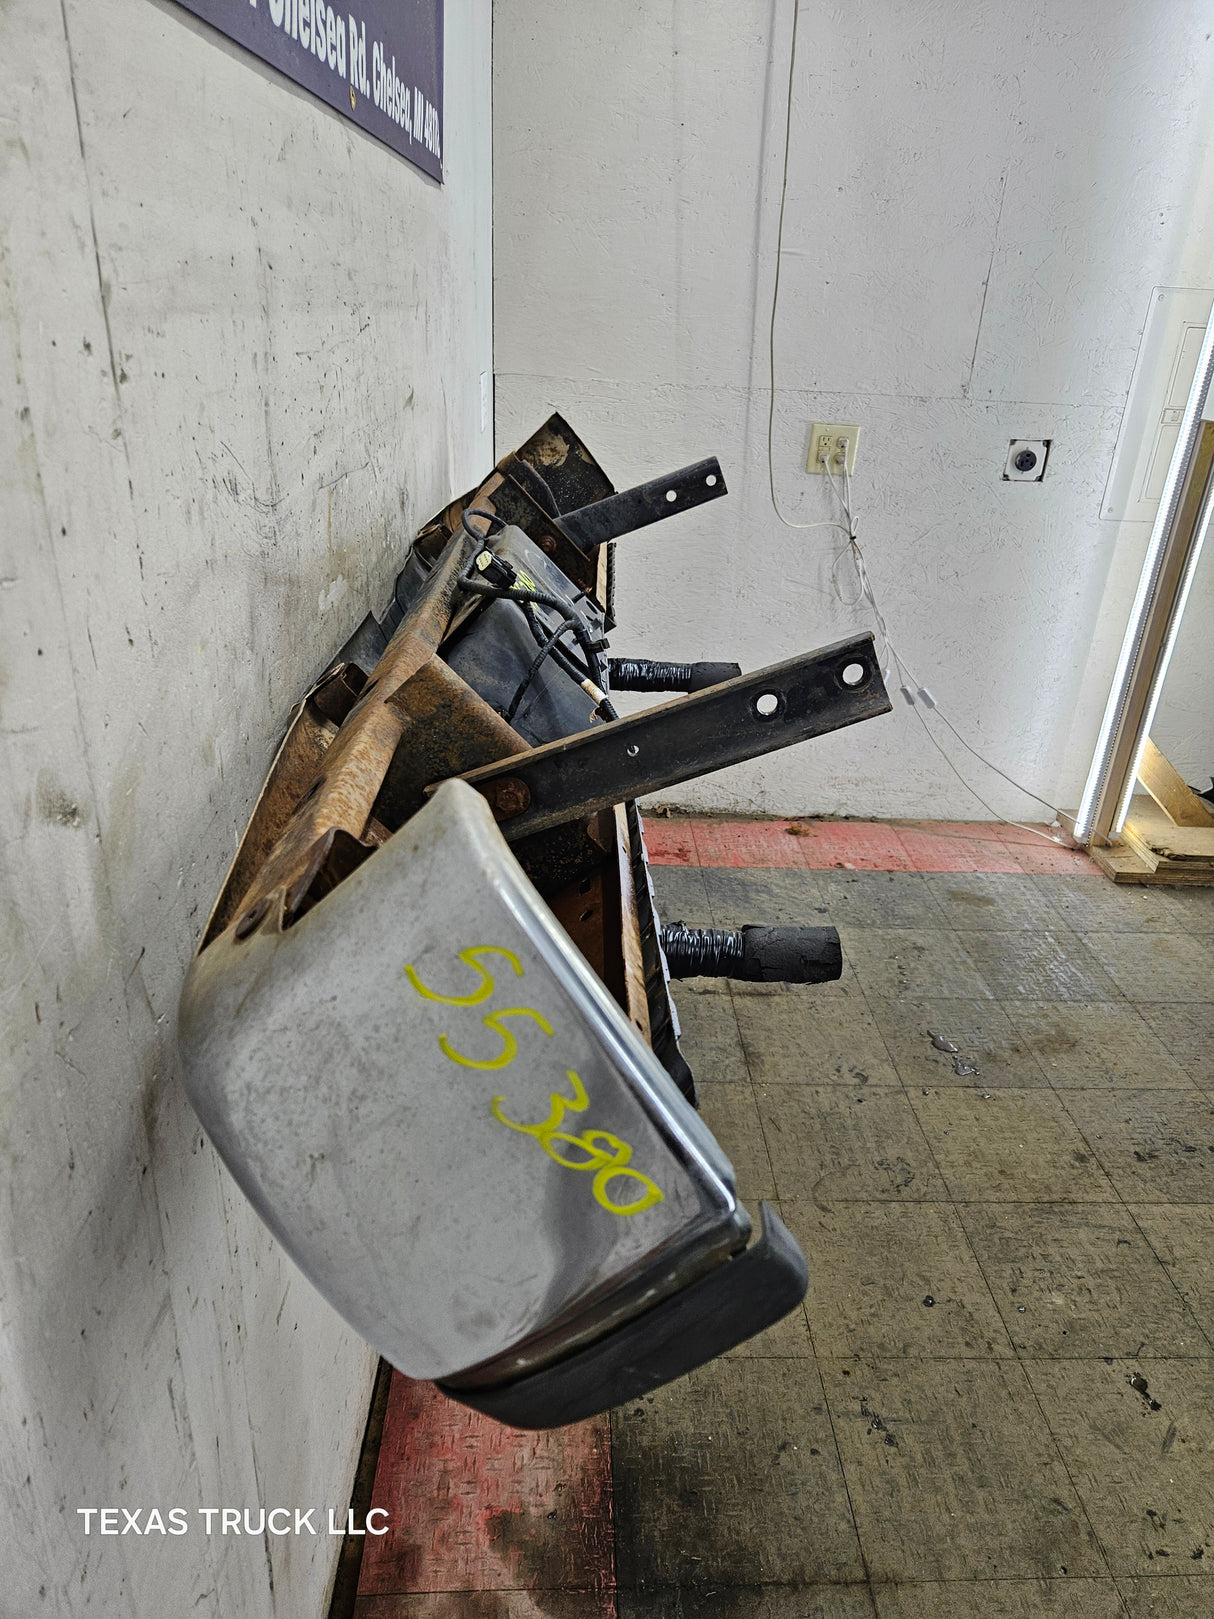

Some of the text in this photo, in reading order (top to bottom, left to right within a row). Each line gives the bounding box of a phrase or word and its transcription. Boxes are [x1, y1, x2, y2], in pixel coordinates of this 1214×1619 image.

[269, 0, 347, 79] elsea
[348, 14, 371, 100] Rd.
[373, 41, 413, 145] Chelsea,
[413, 85, 424, 143] MI
[404, 945, 665, 1216] 55380
